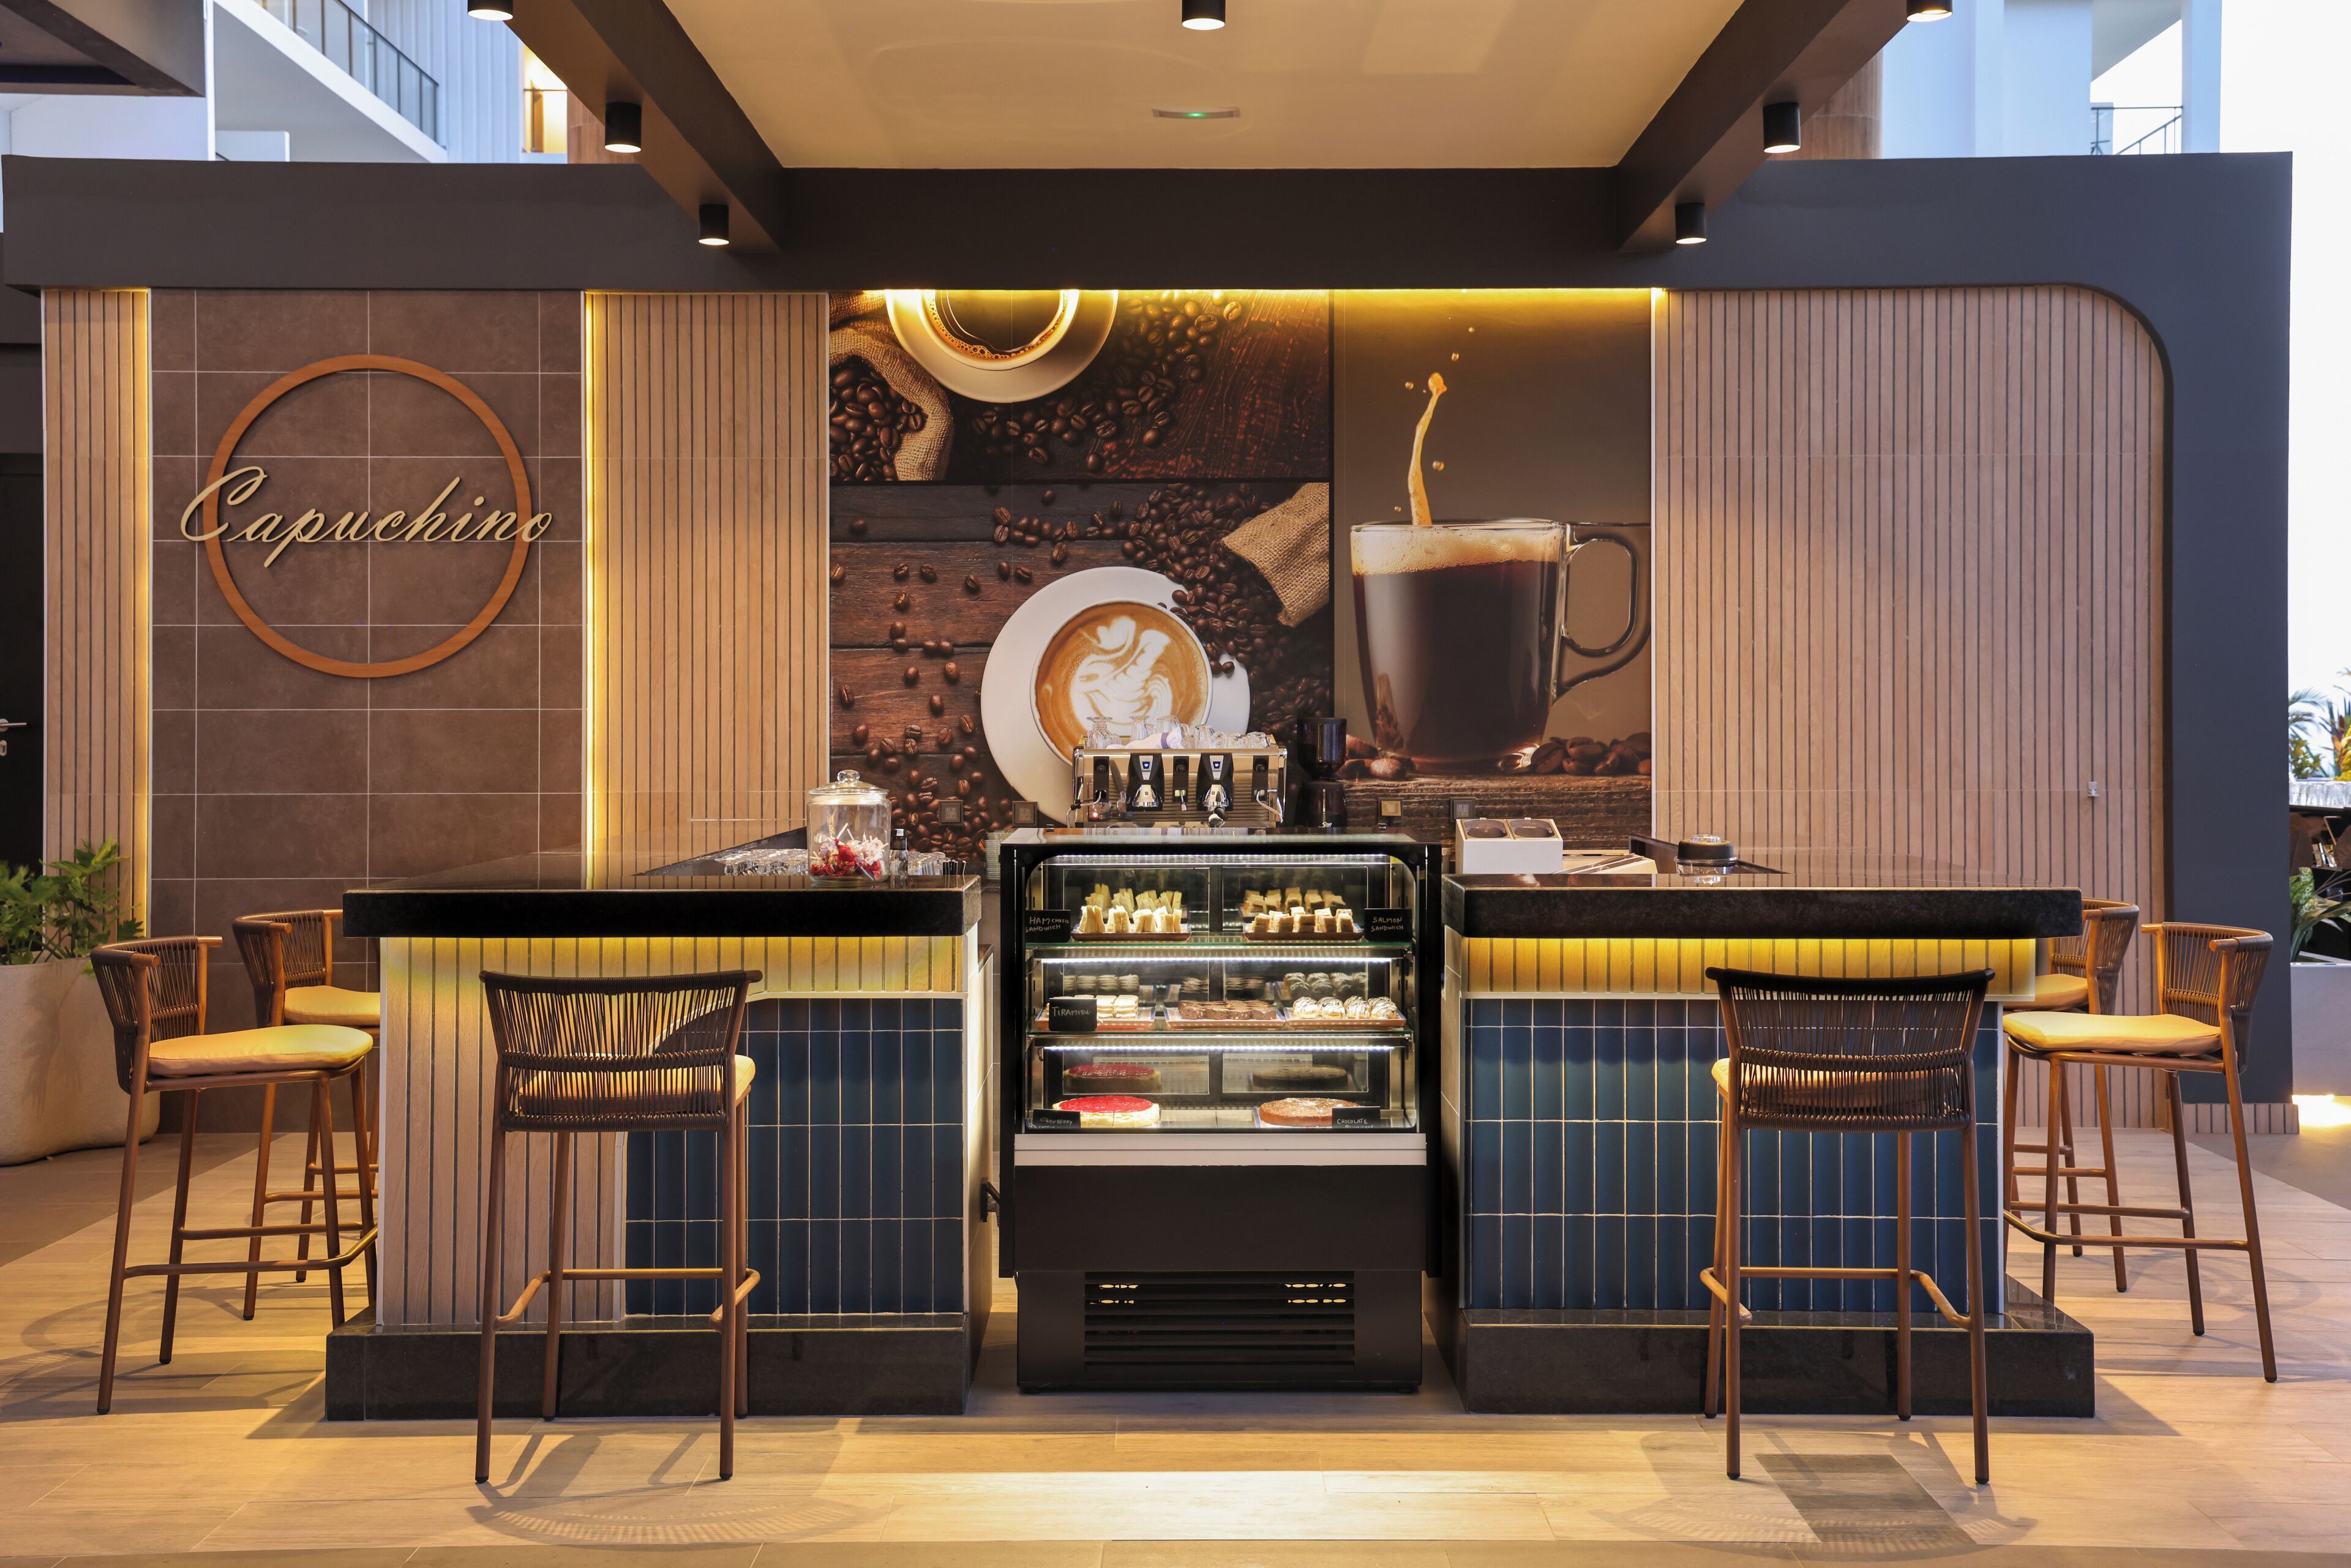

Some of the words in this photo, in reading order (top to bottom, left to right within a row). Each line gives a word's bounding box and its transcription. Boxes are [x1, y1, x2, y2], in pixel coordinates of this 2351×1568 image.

[181, 466, 552, 567] Capuchino
[1029, 916, 1050, 925] HAM
[1025, 924, 1060, 933] SANDWICH
[1040, 1117, 1073, 1126] STRAWBERRY
